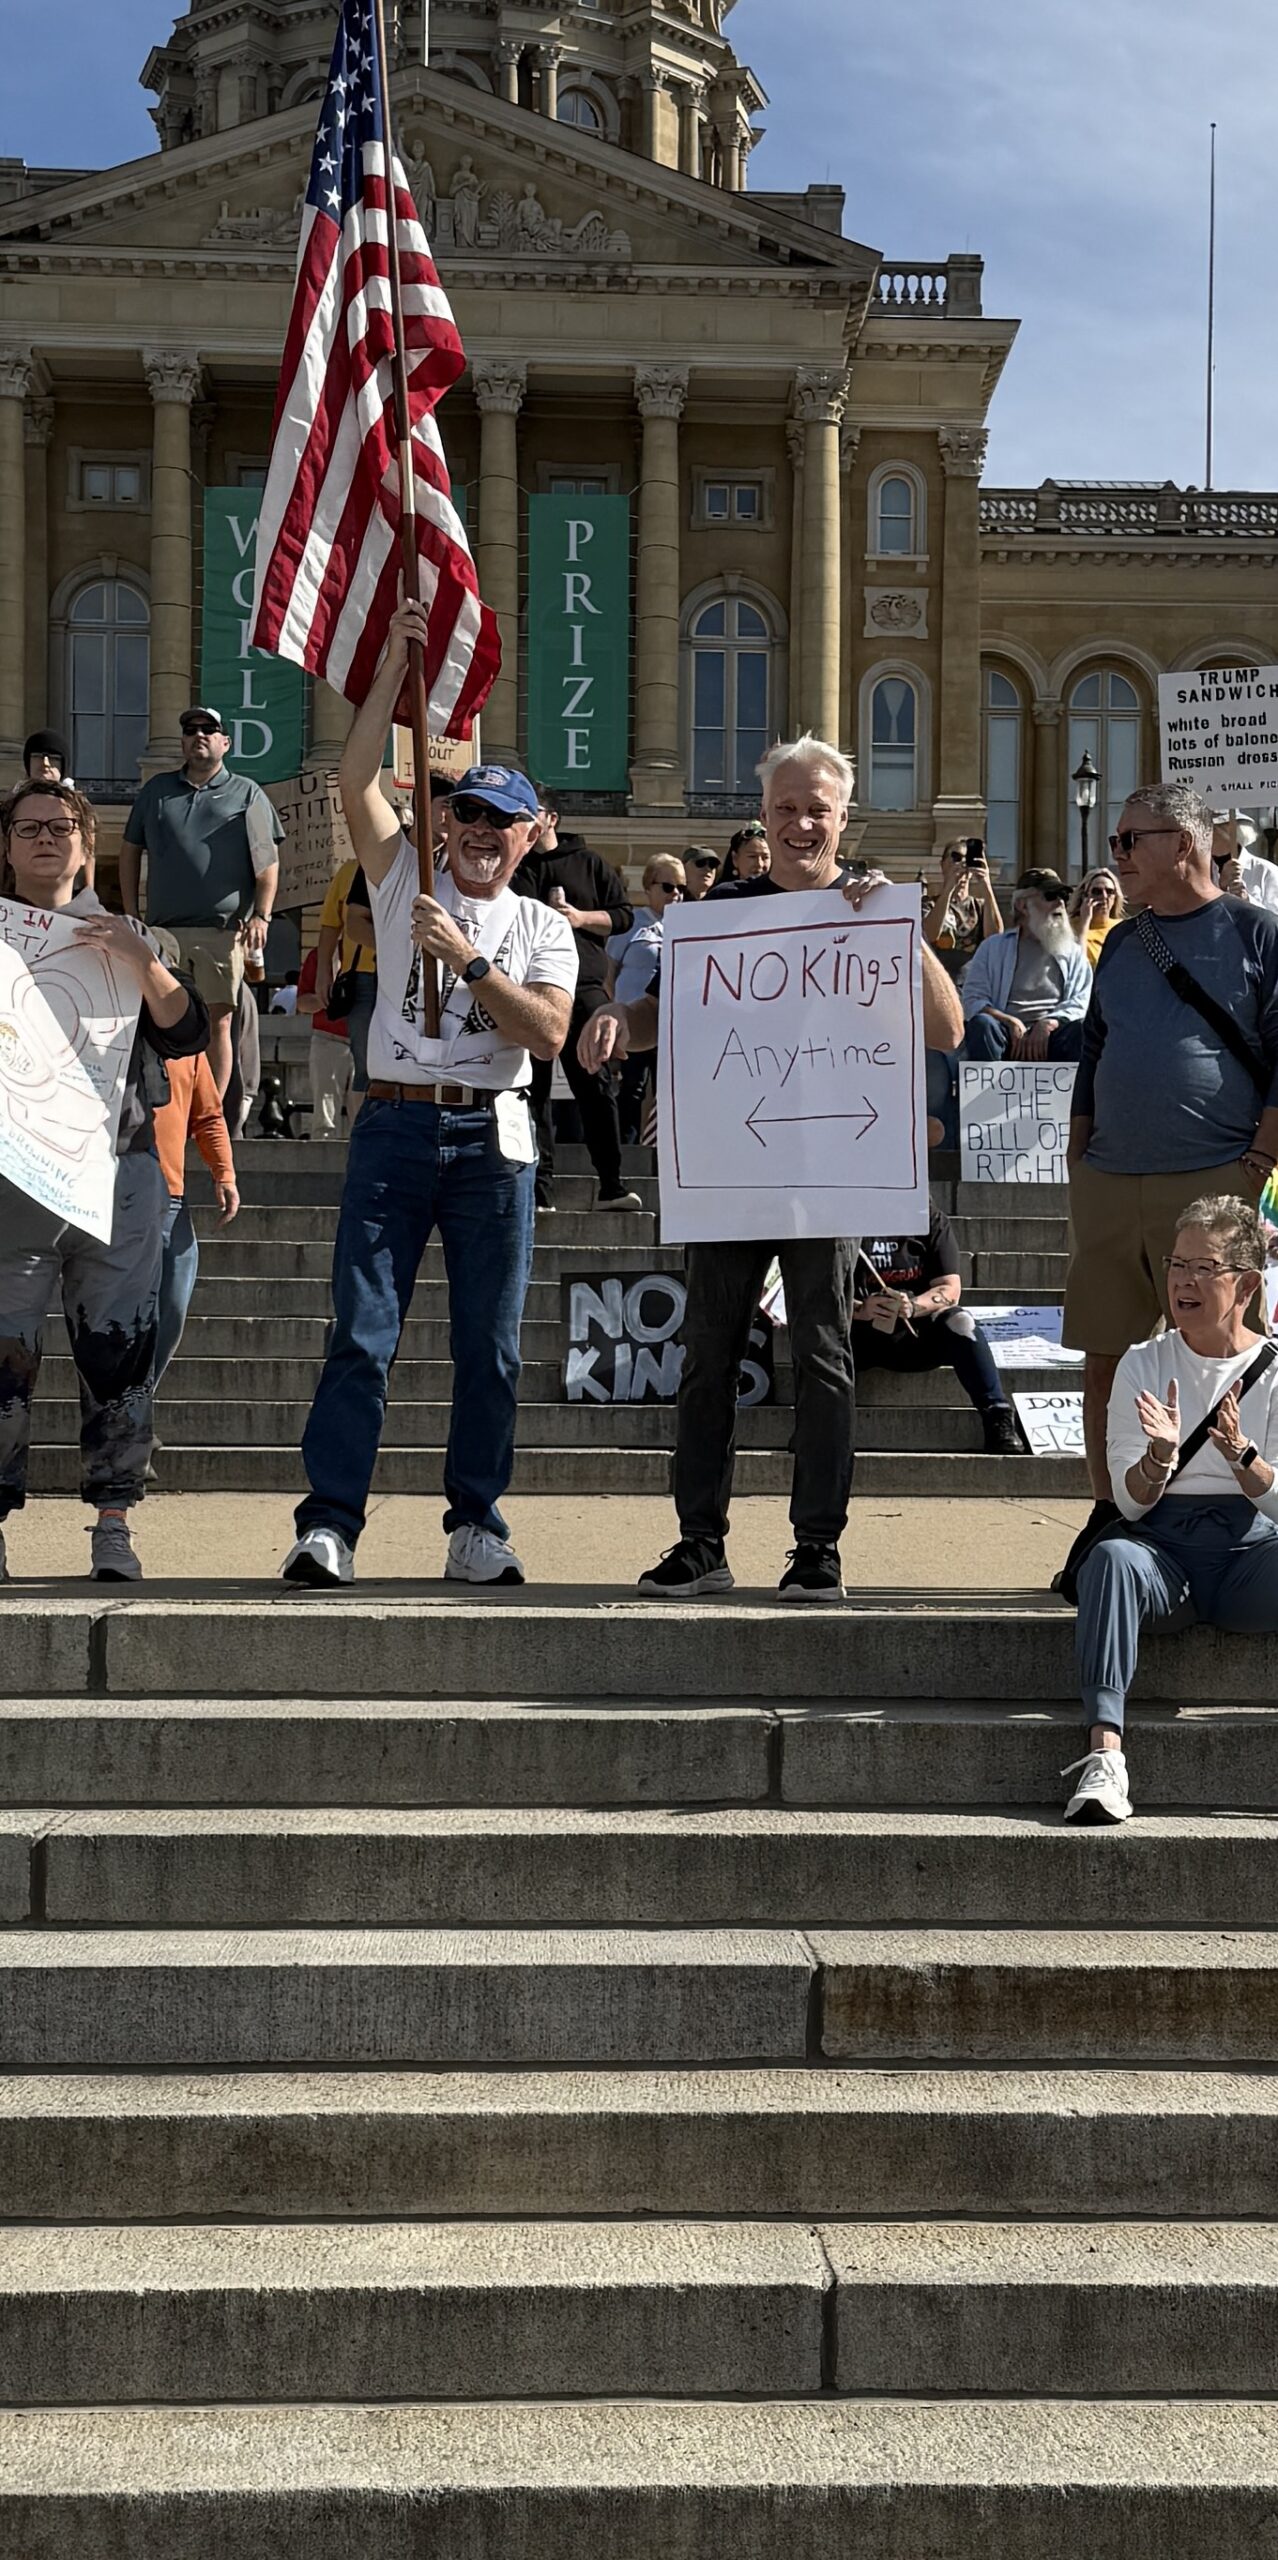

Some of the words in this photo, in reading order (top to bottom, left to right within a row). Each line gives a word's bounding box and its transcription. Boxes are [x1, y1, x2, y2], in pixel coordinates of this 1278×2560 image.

[561, 519, 603, 769] PRIZE
[1199, 668, 1260, 686] TRUMP
[1177, 684, 1278, 704] SANDWICH
[1167, 717, 1210, 733] white
[1168, 738, 1197, 752] lots
[1204, 734, 1220, 748] of
[1168, 755, 1225, 770] Russian
[295, 834, 346, 853] KINGS
[703, 950, 789, 1006] NO
[713, 1027, 896, 1087] Anytime
[998, 1091, 1054, 1120] THE
[968, 1123, 1030, 1151] BILL
[1038, 1122, 1070, 1150] OF
[570, 1274, 688, 1344] NO
